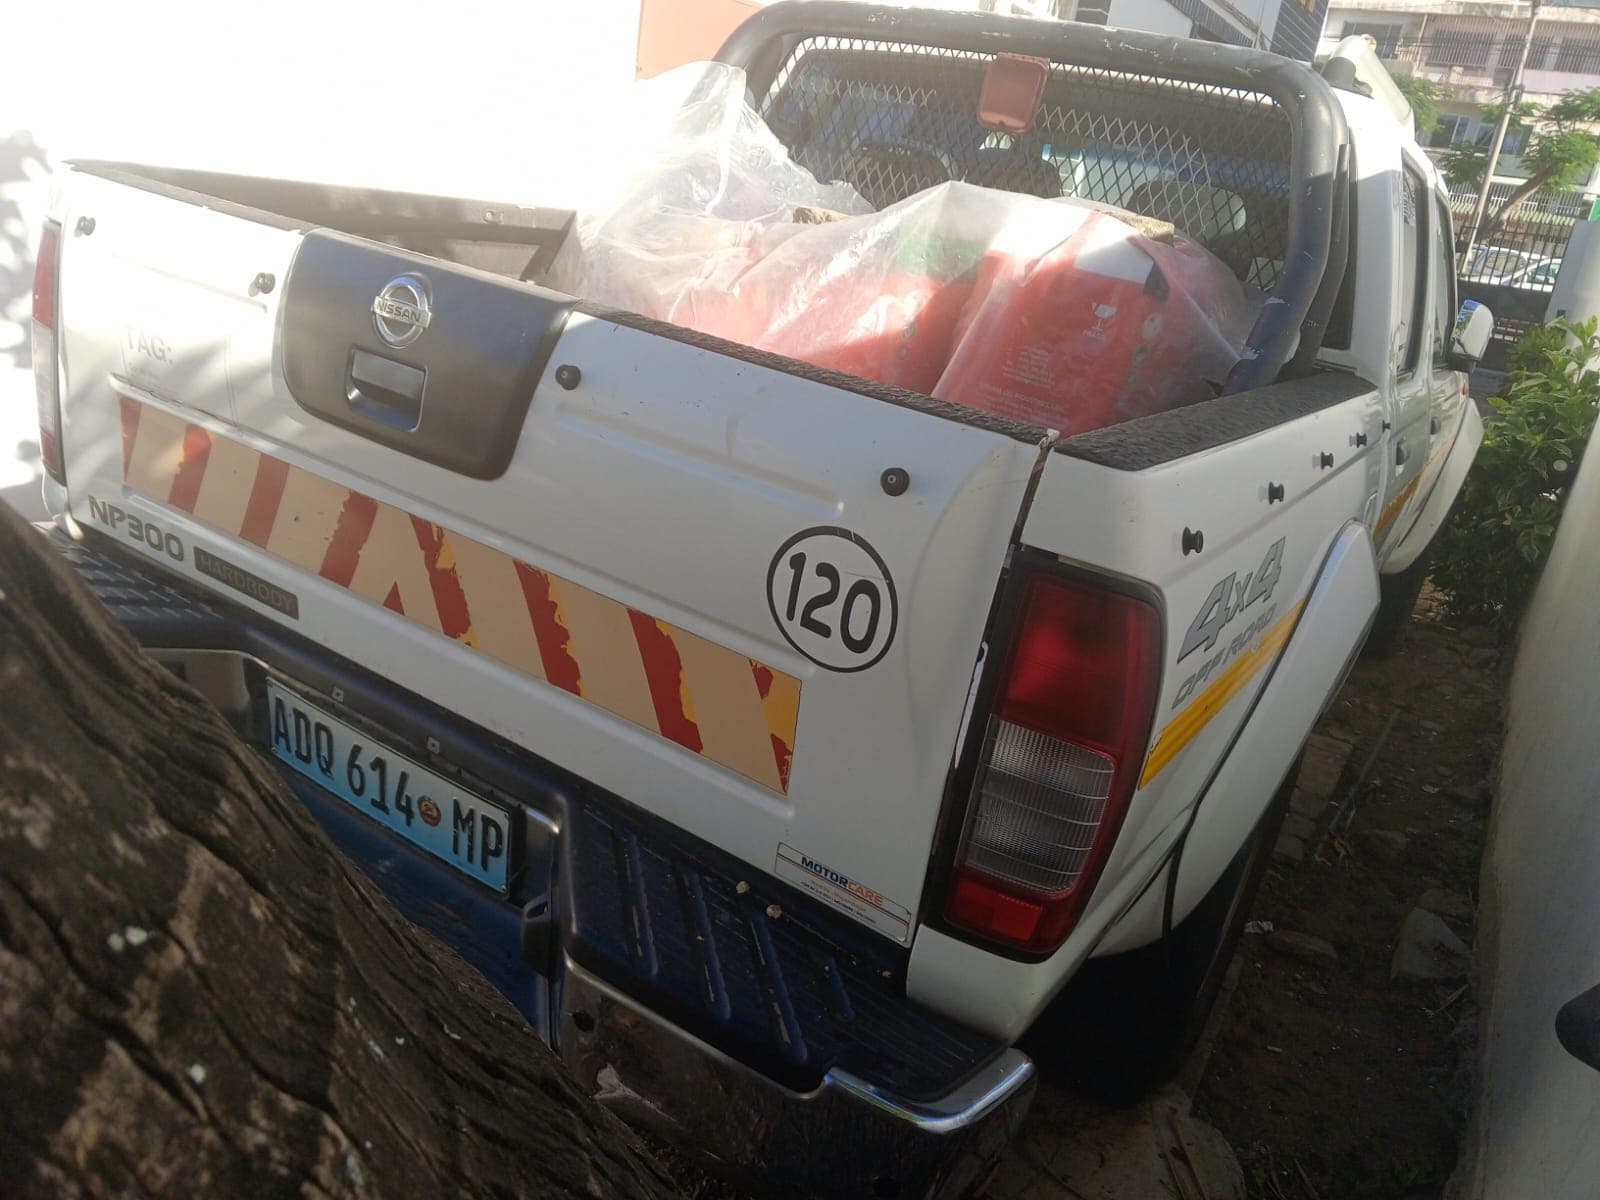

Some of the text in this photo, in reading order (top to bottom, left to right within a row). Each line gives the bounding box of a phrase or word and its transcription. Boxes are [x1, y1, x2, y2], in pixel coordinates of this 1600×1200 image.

[377, 299, 421, 322] NISSAN
[88, 494, 295, 613] NP300 HARDBODY
[786, 551, 881, 654] 120
[1171, 648, 1226, 710] OFF
[275, 697, 503, 873] ADQ 614 MP
[801, 855, 884, 906] MOTORCARE
